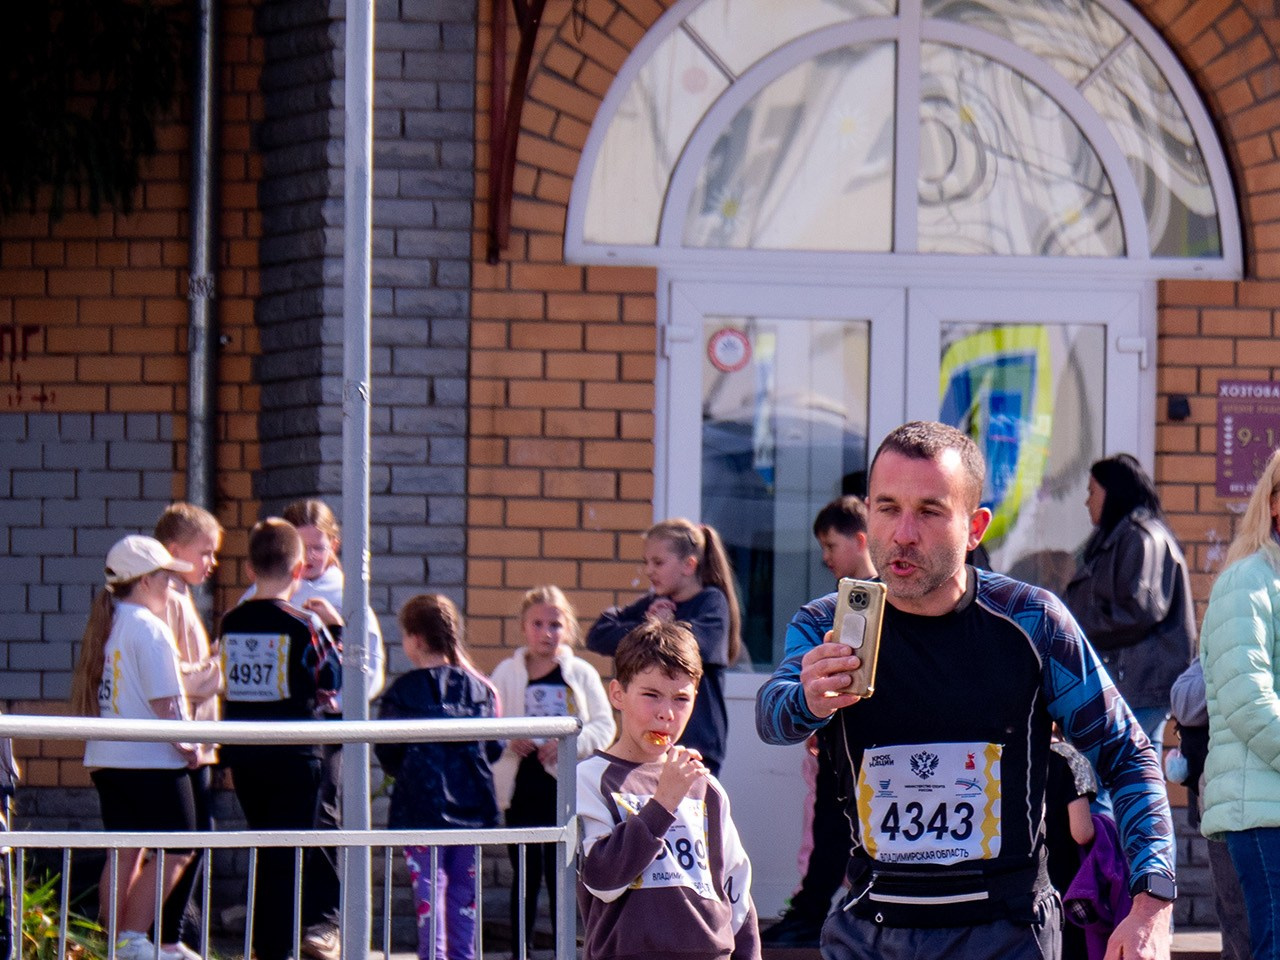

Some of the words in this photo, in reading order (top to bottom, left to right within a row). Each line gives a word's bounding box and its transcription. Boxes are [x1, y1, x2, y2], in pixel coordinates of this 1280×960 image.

[229, 664, 273, 685] 4937
[880, 801, 975, 842] 4343
[880, 852, 935, 863] ВЛАДИМИРСКАЯ
[936, 848, 969, 859] ОБЛАСТЬ
